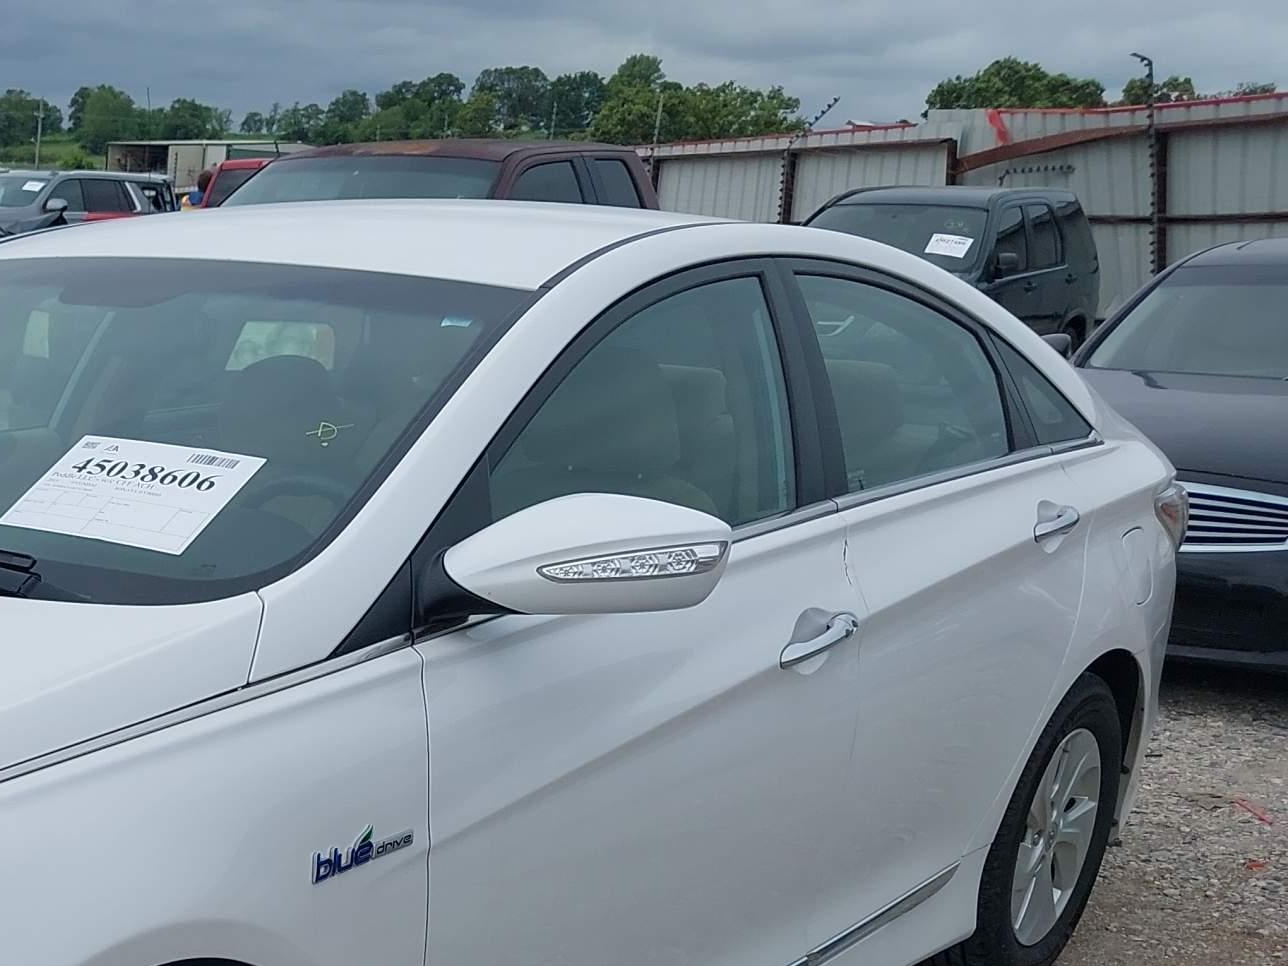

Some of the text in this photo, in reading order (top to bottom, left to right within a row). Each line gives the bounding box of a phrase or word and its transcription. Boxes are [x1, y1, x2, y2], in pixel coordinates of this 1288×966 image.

[72, 457, 224, 491] 45038606
[312, 834, 412, 885] blue drive
